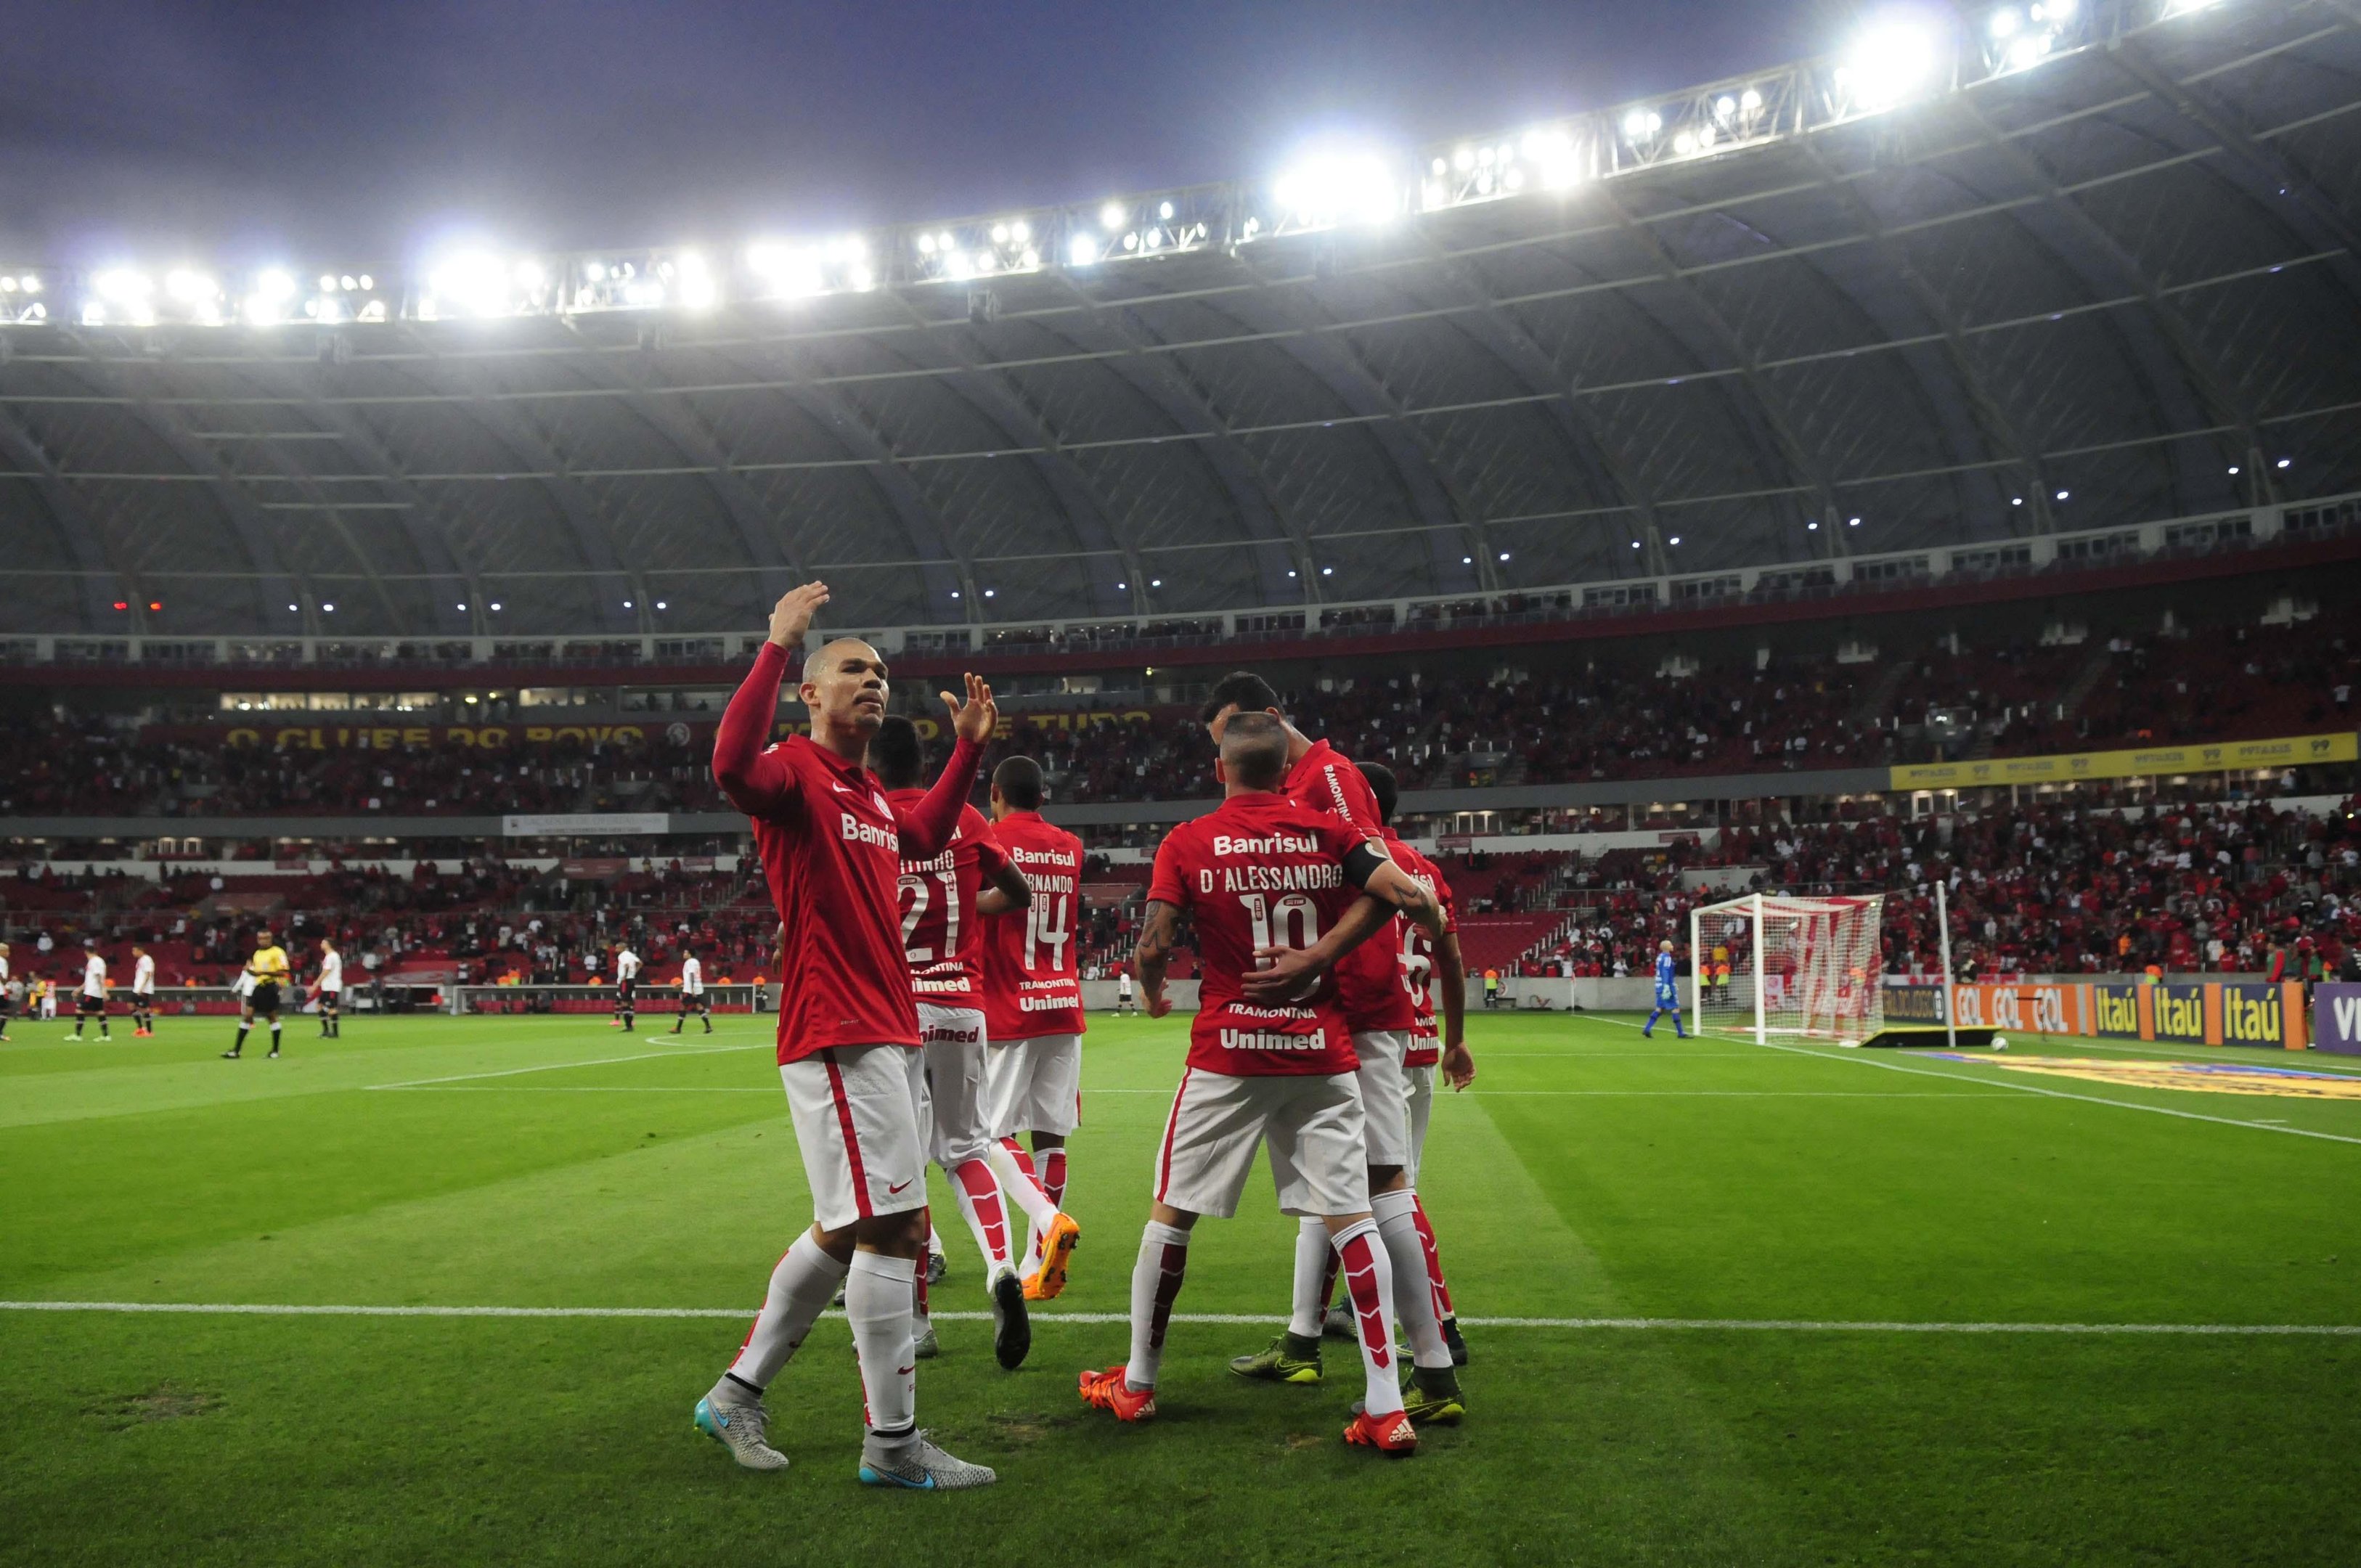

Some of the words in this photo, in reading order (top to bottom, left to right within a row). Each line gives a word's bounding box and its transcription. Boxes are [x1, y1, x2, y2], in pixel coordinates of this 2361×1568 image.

[1012, 846, 1076, 867] Banrisul
[1213, 830, 1319, 857] Banrisul
[1022, 873, 1073, 894] RNANDO
[1199, 863, 1344, 894] D'ALESSANDRO
[897, 869, 960, 963] 21
[1024, 891, 1069, 971] 14
[1238, 893, 1321, 1003] 10
[1228, 1003, 1318, 1020] TRAMONTNA
[1957, 987, 1984, 1026] GOL
[1992, 987, 2023, 1030] GOL
[2095, 987, 2137, 1032] Itaú
[2153, 987, 2202, 1037] Itaú
[2224, 987, 2280, 1042] Itaú
[919, 1024, 979, 1044] nimed
[1220, 1028, 1326, 1050] Unimed
[1388, 1431, 1416, 1442] adida
